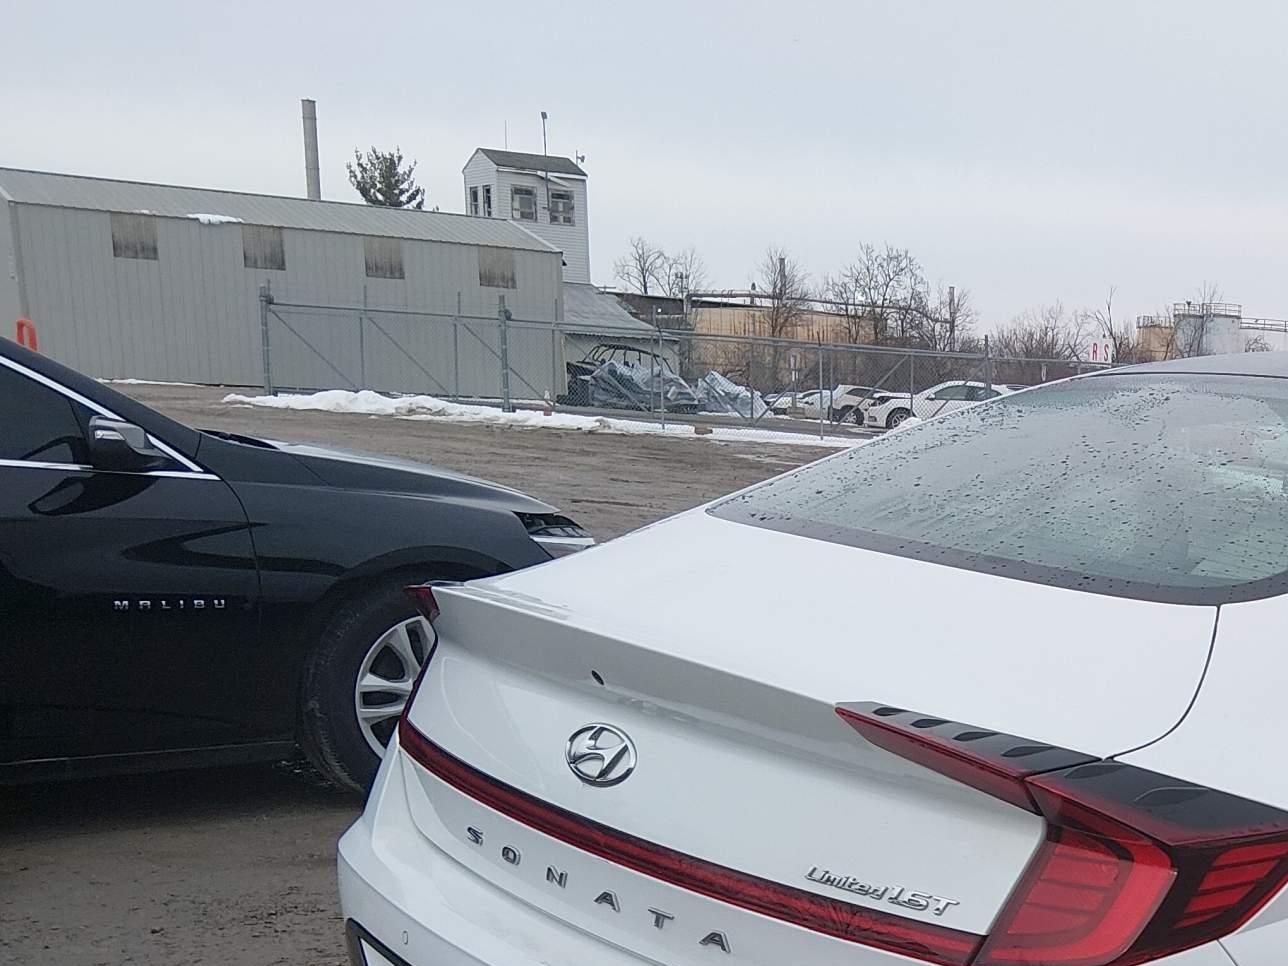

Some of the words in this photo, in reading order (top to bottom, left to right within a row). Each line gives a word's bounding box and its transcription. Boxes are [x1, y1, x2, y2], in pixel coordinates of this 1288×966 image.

[113, 598, 226, 610] MALIBU
[466, 825, 732, 954] SONATA
[804, 864, 889, 901] Limited
